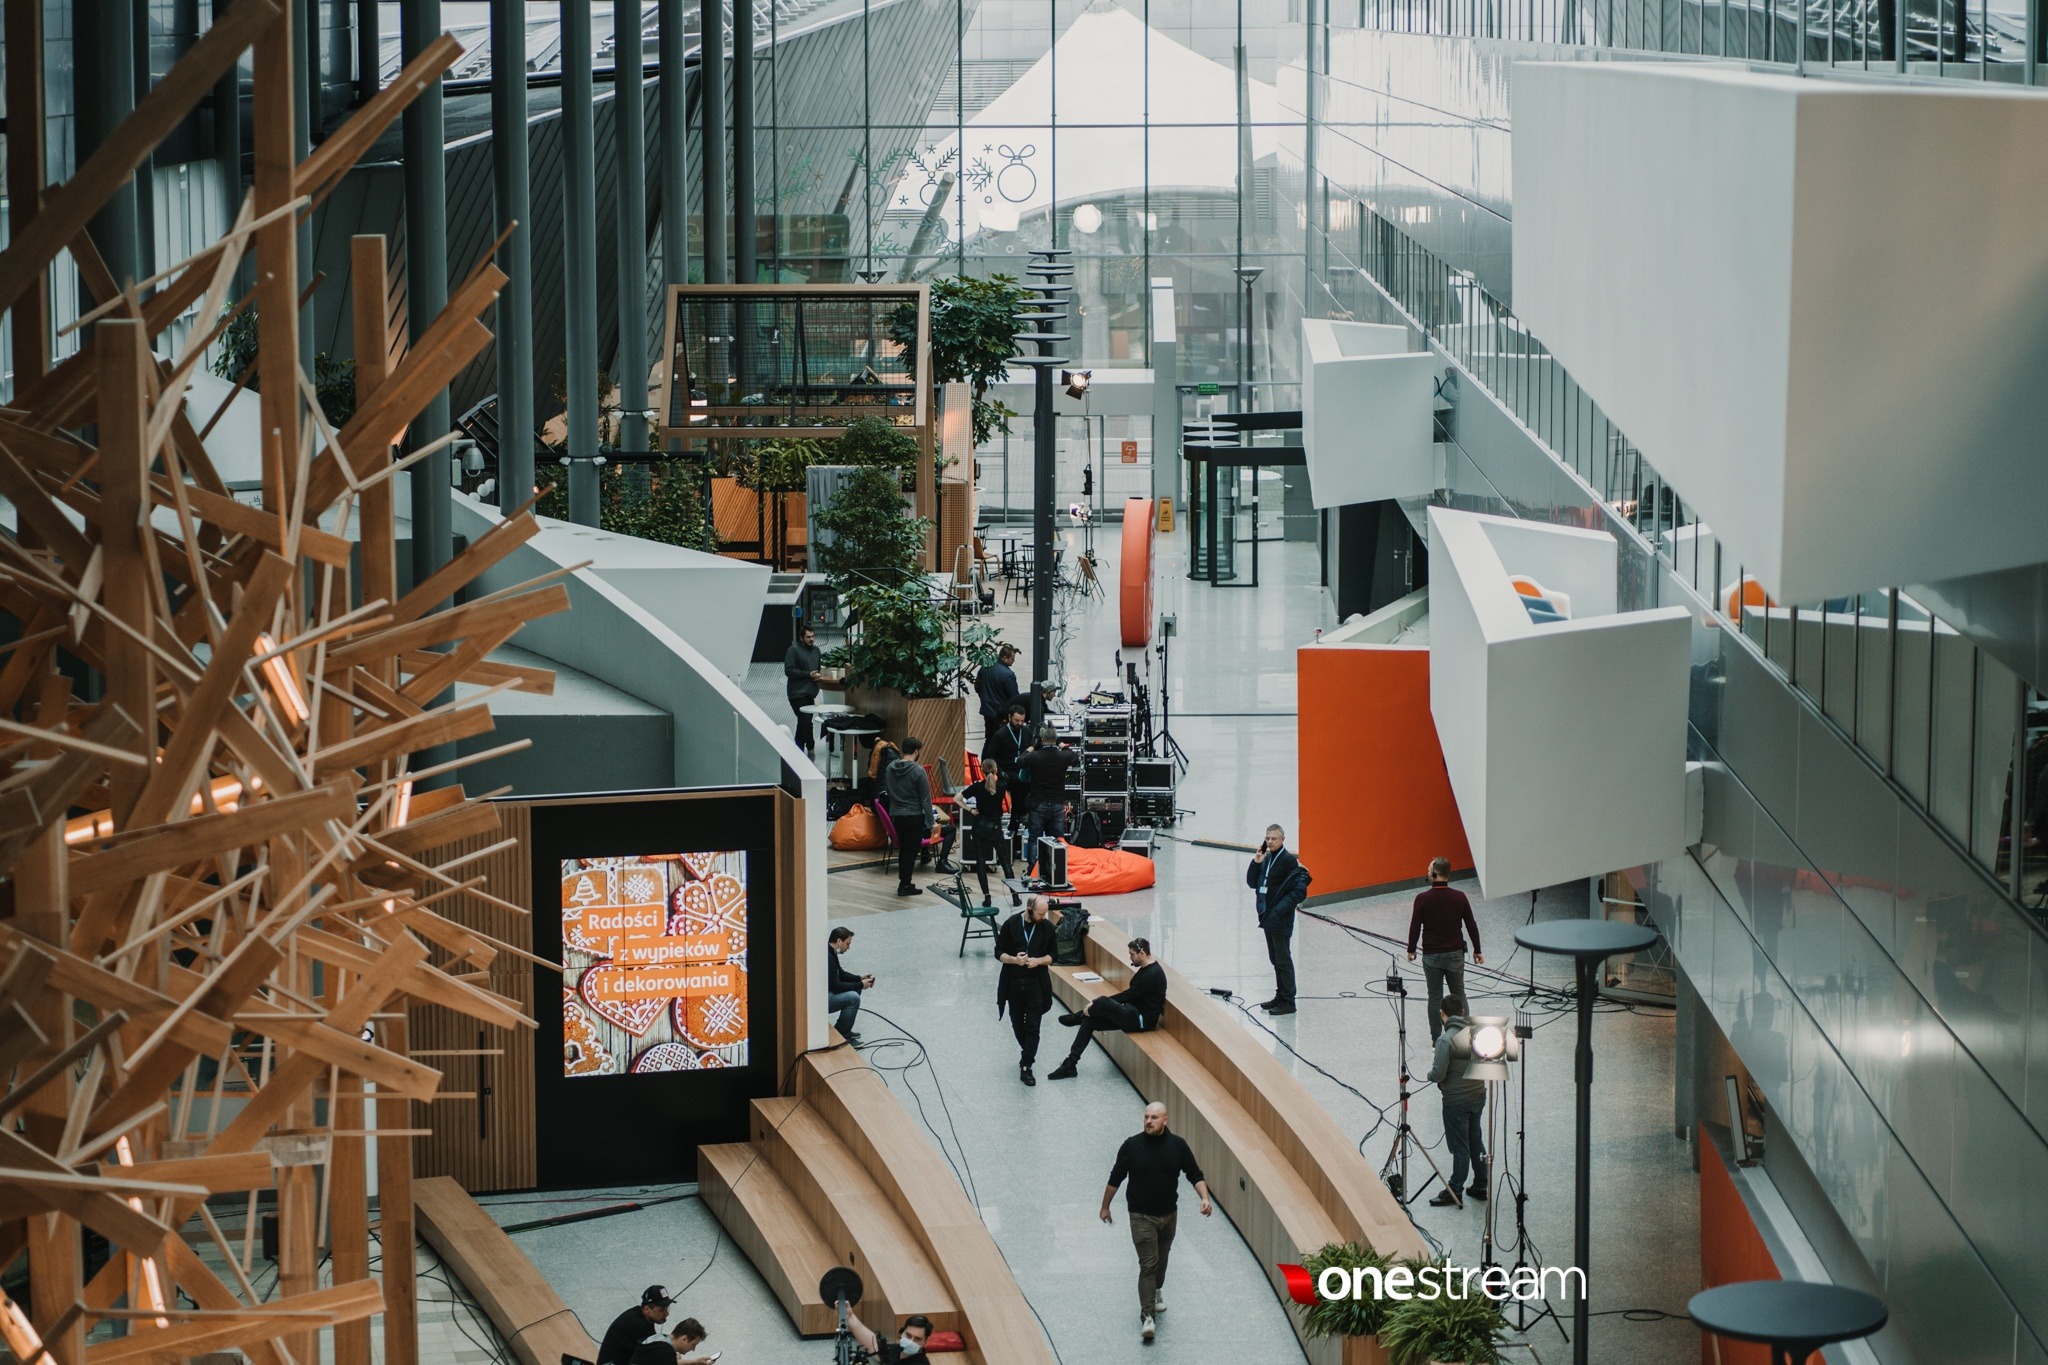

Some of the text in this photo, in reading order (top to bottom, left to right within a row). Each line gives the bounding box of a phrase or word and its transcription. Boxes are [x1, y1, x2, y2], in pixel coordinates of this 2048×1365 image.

[588, 910, 658, 930] Radości
[619, 940, 720, 964] z wypieków
[603, 970, 729, 994] i dekorowania
